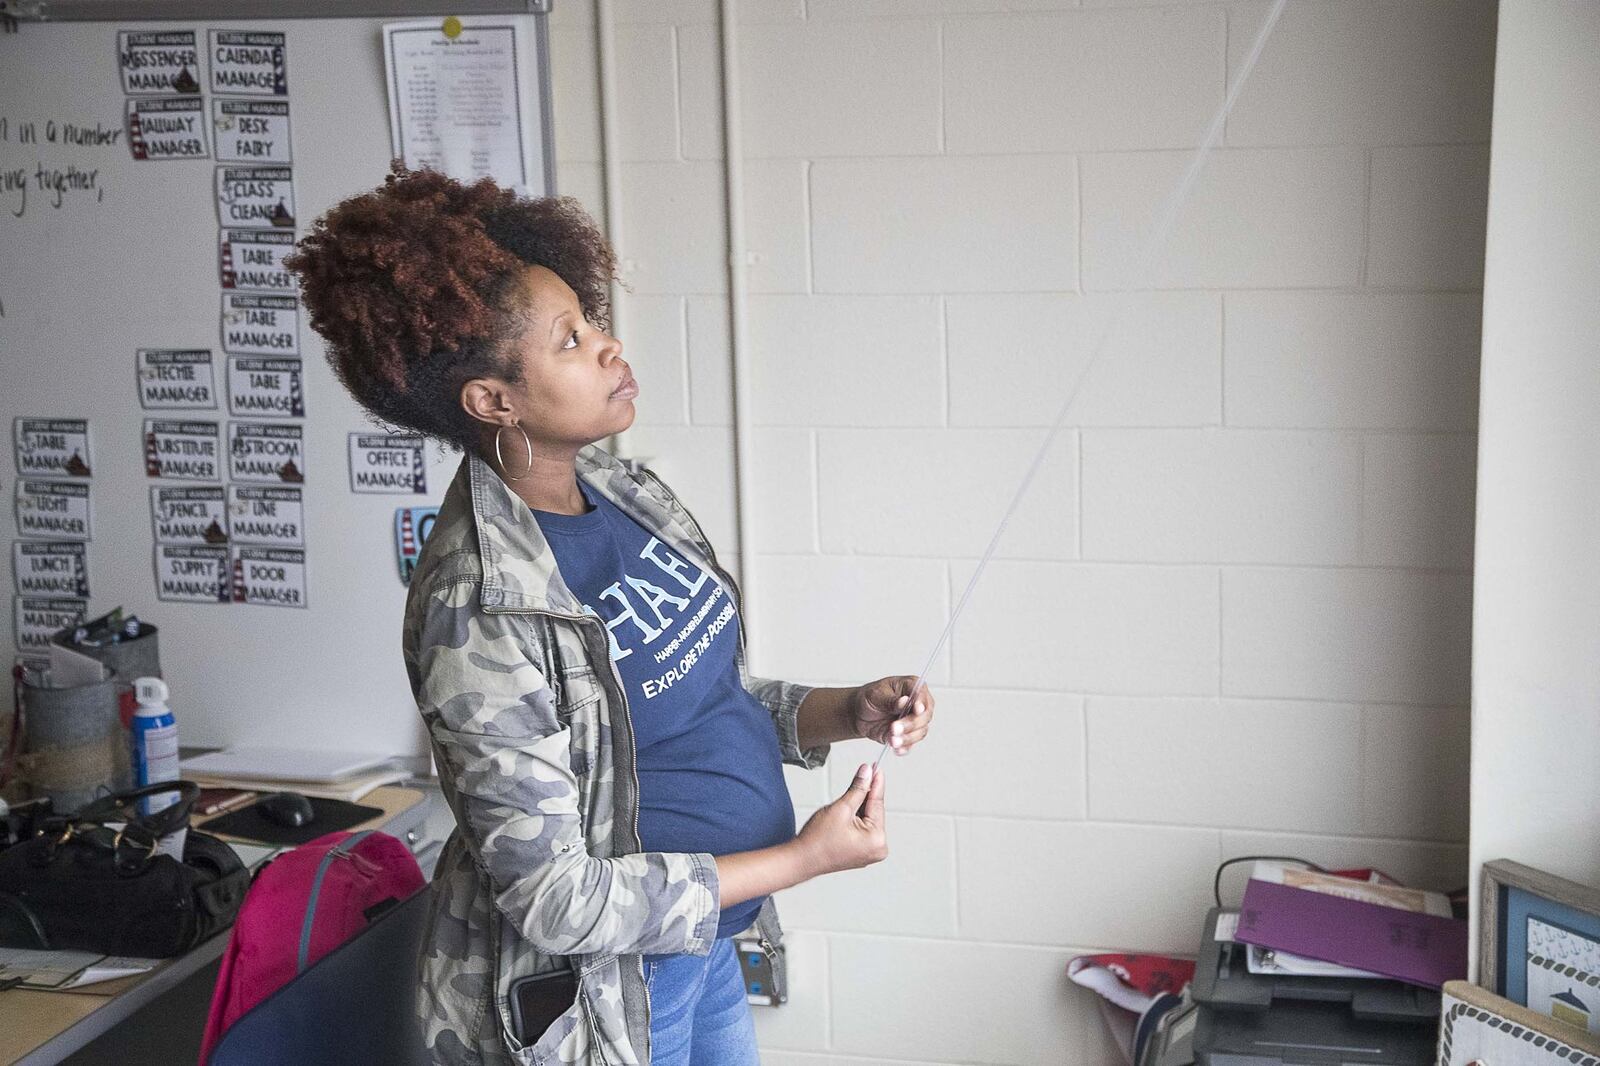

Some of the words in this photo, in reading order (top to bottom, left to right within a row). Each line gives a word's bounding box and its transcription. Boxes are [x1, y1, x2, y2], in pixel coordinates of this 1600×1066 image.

[122, 50, 196, 67] MESSENGER
[216, 71, 275, 88] MANAGE
[20, 122, 37, 144] in
[46, 120, 56, 142] a
[63, 122, 122, 146] number
[239, 118, 269, 134] DESK
[236, 140, 274, 157] FAIRY
[35, 161, 103, 209] together,
[234, 182, 274, 198] CLASS
[230, 204, 275, 220] CLEANE
[242, 249, 273, 265] TABLE
[246, 310, 276, 327] TABLE
[229, 332, 293, 348] MANAGER
[158, 365, 195, 381] TECHIE
[249, 373, 280, 389] TABLE
[145, 386, 209, 401] MANAGER
[234, 395, 292, 411] MANAGE
[35, 434, 66, 451] TABLE
[367, 451, 408, 466] OFFICE
[357, 472, 414, 488] MANAGE
[37, 497, 68, 513] LIGHT
[170, 502, 208, 518] PENCIL
[253, 501, 276, 517] LINE
[23, 516, 84, 533] MANAGER
[234, 522, 297, 538] MANAGER
[31, 558, 69, 572] LUNCH
[171, 560, 214, 575] SUPPLY
[251, 566, 285, 581] DOOR
[22, 578, 74, 592] MANAGE
[162, 581, 218, 597] MANAGE
[641, 648, 698, 699] EXPLORE
[694, 633, 711, 656] THE
